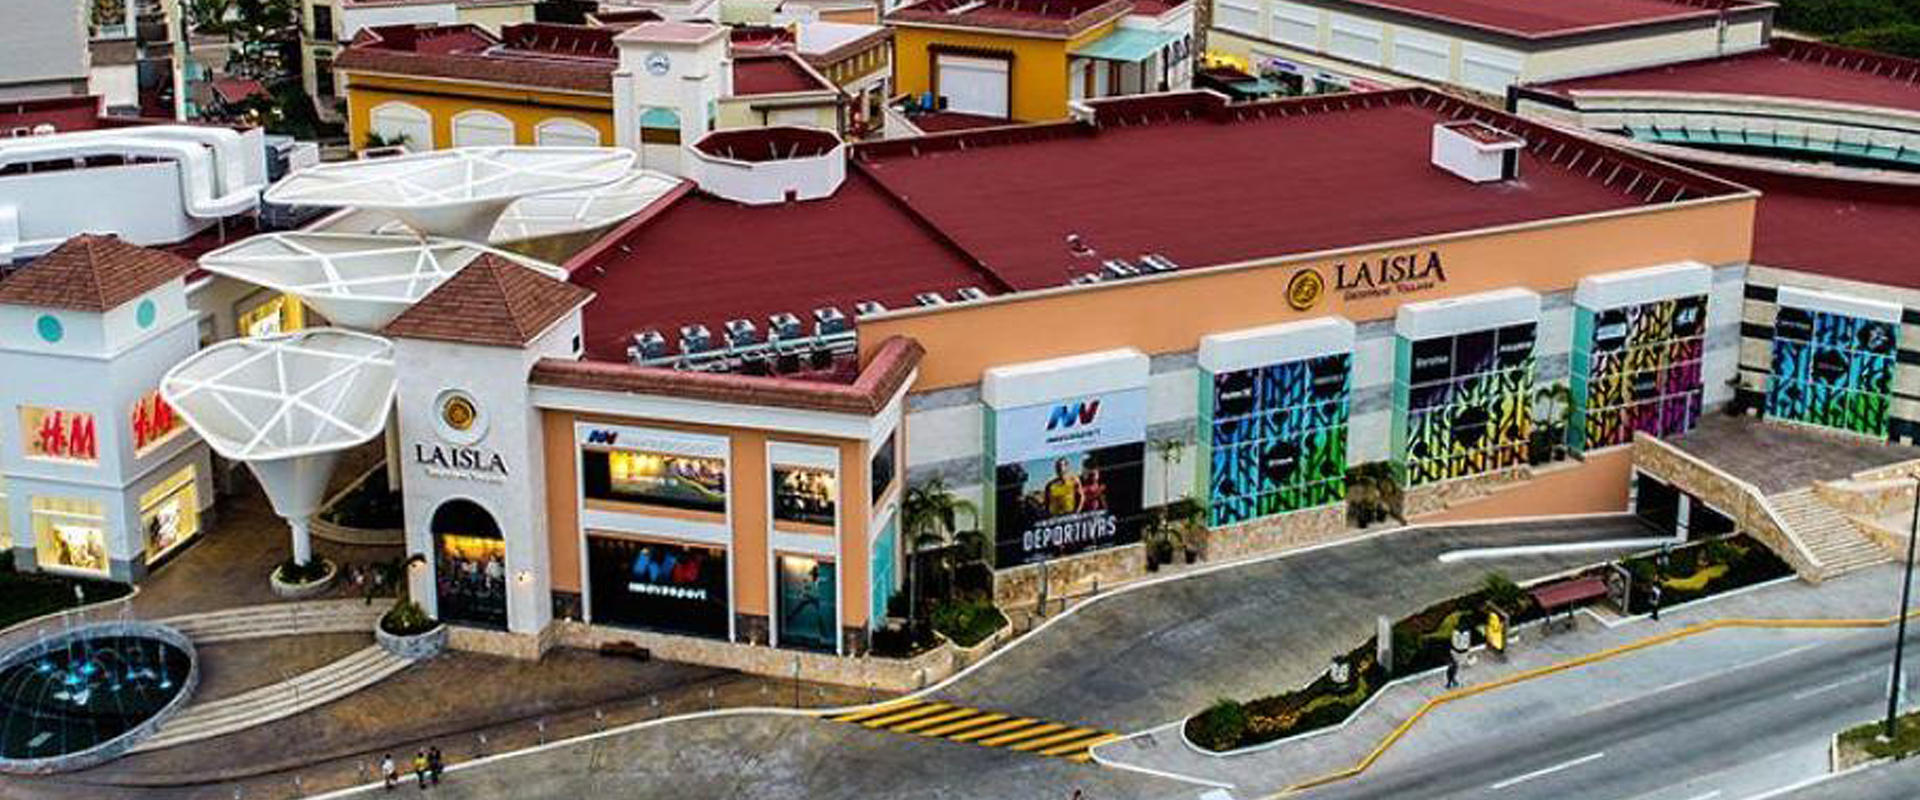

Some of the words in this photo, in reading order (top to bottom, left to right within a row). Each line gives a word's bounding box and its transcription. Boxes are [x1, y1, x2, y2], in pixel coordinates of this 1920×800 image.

[1334, 261, 1376, 290] LA
[1378, 250, 1447, 285] ISLA
[414, 443, 450, 470] LA
[450, 446, 509, 477] ISLA
[1022, 515, 1117, 551] DEPORTIVAS
